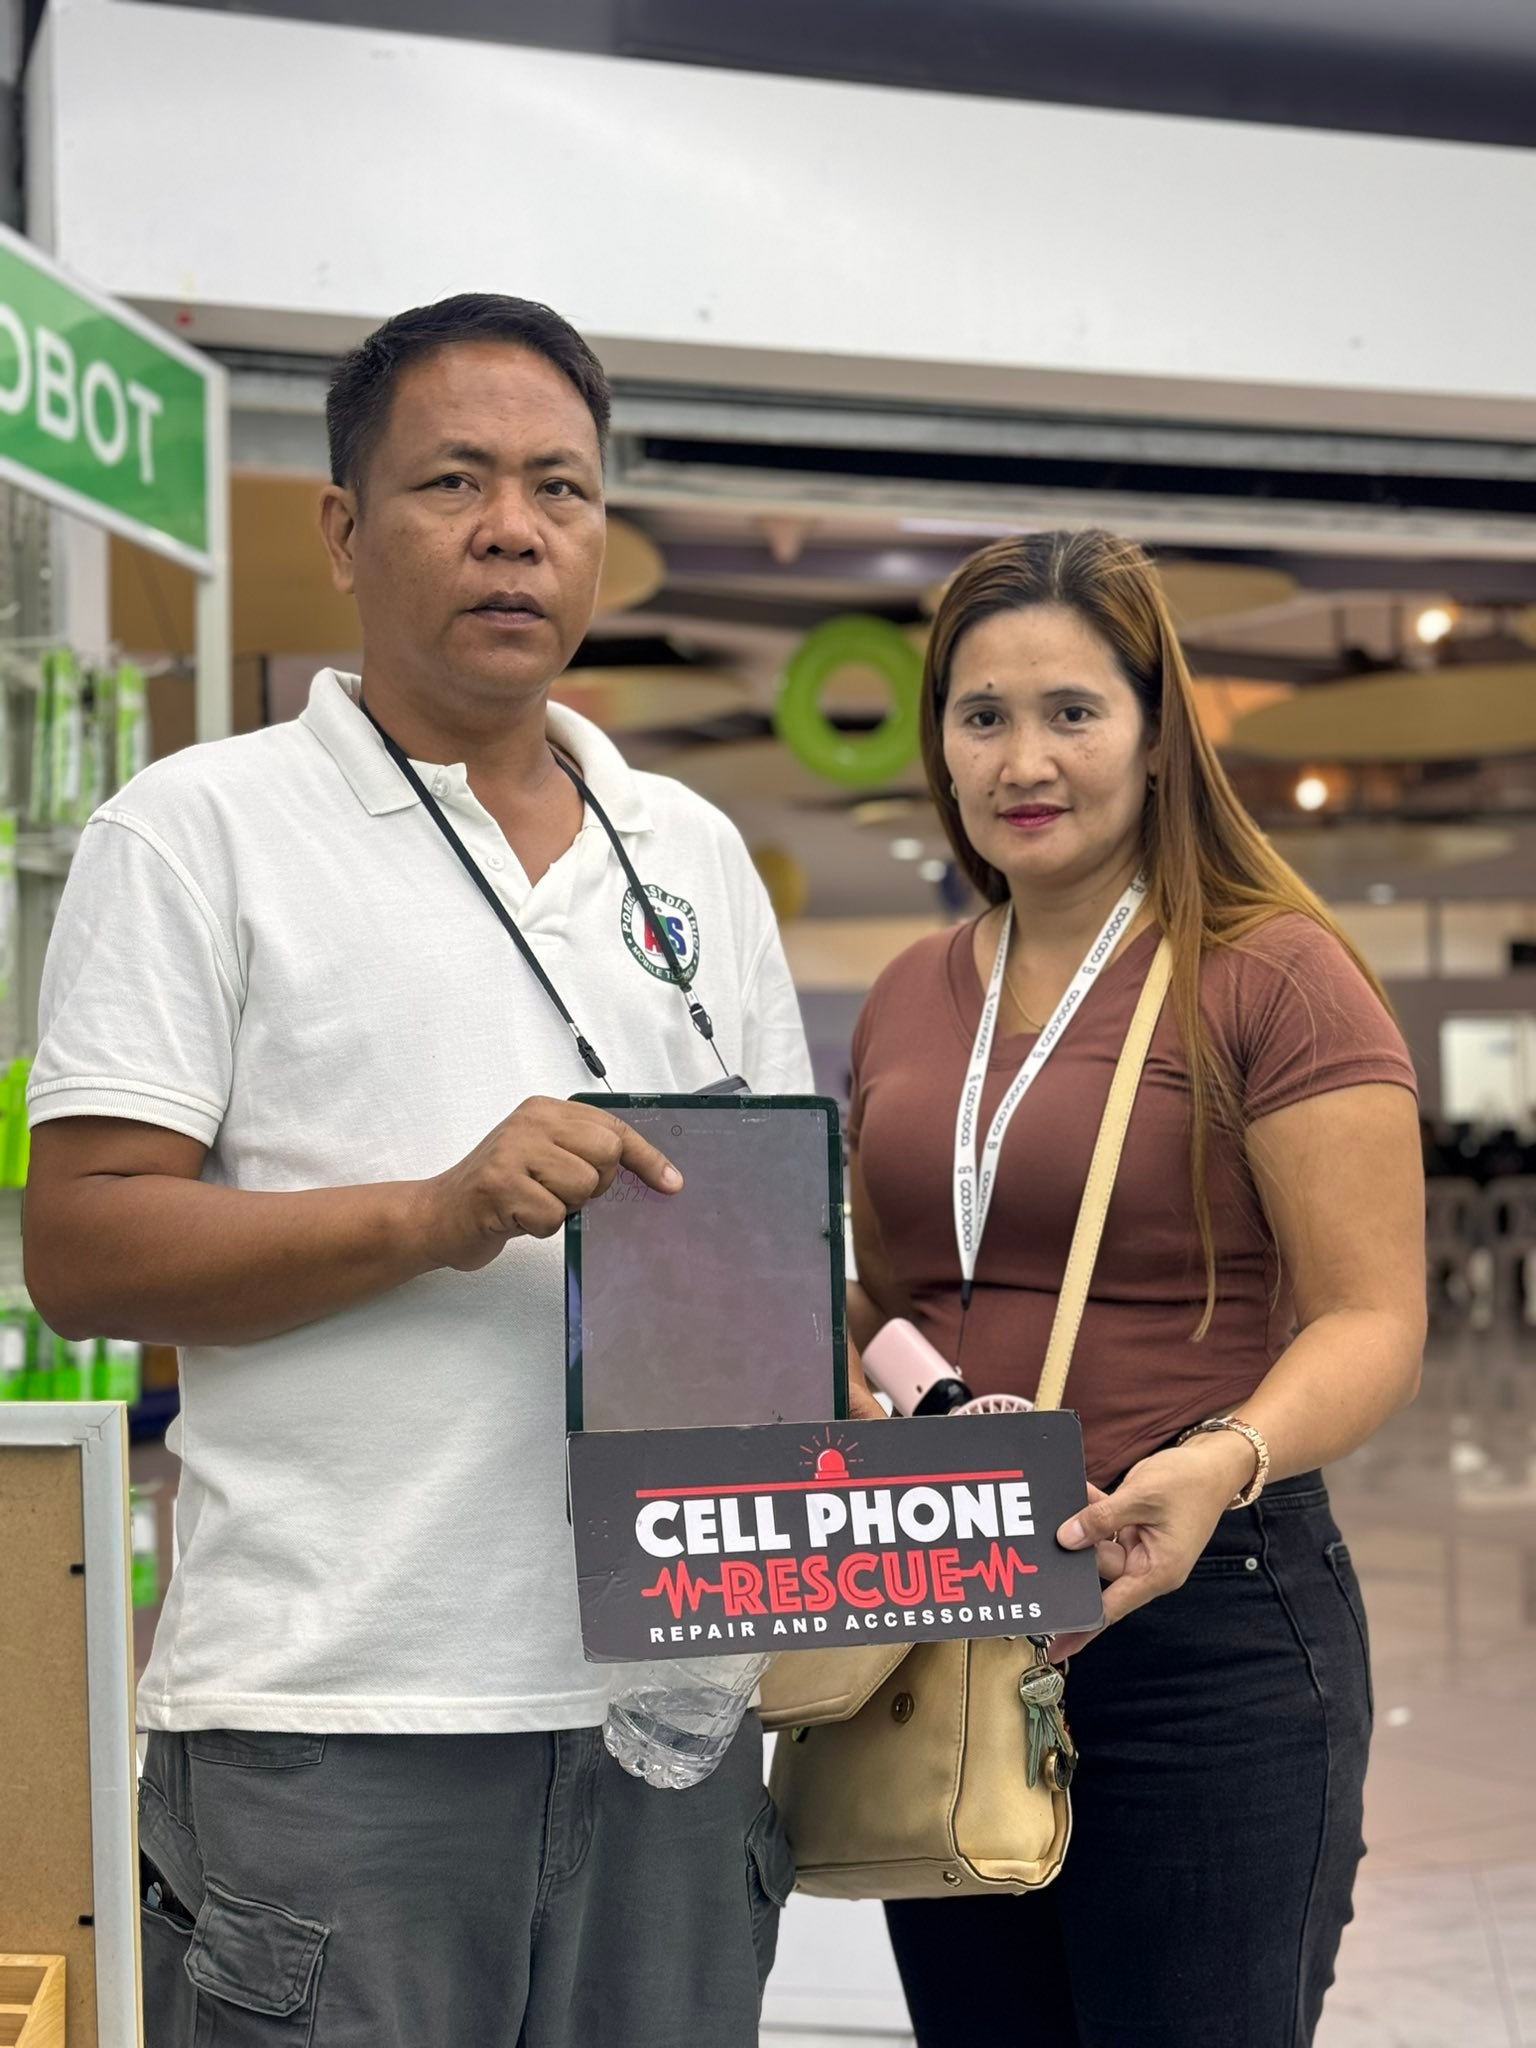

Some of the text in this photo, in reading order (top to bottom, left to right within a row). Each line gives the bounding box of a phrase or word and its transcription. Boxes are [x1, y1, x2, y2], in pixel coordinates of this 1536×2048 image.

[635, 1482, 1035, 1558] CELL PHONE
[720, 1549, 965, 1617] RESCUE
[649, 1603, 1042, 1643] REPAIR AND ACCESSORIES
